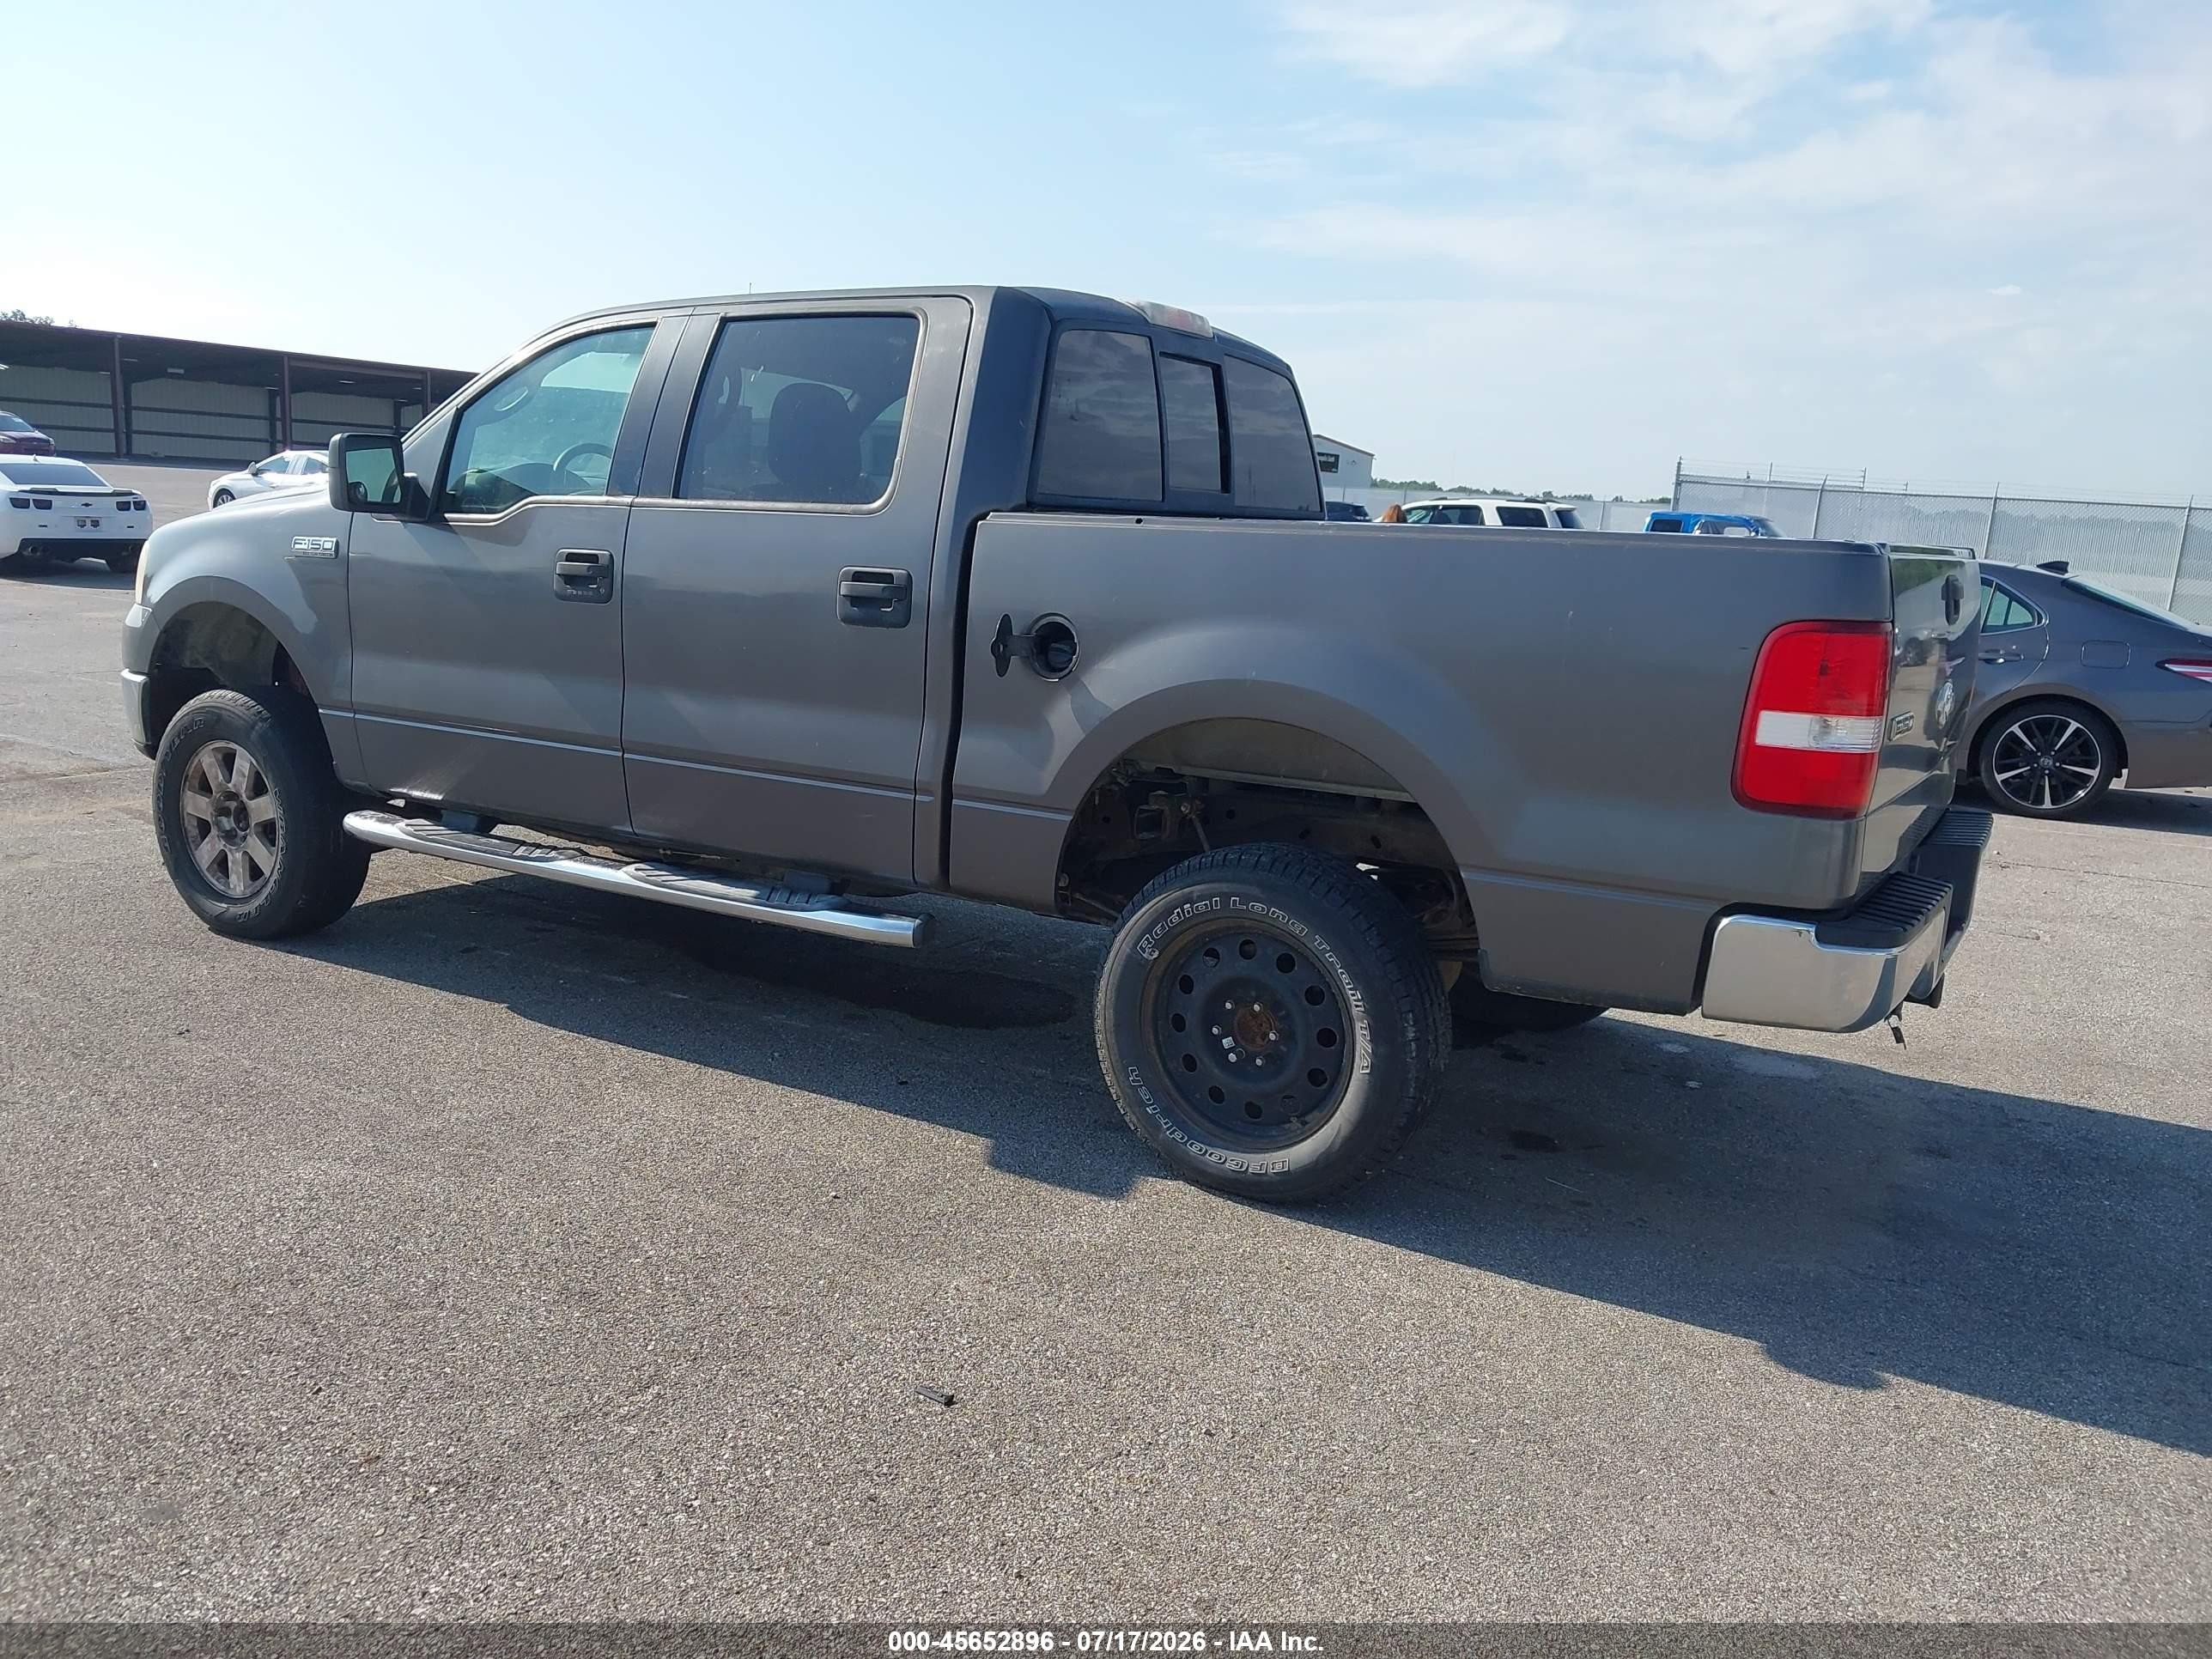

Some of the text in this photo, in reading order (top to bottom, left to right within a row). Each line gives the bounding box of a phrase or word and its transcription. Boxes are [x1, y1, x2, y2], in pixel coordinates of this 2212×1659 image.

[1137, 896, 1372, 1074] Radial Long Trail T/A
[1127, 1066, 1291, 1175] BFGoodrich
